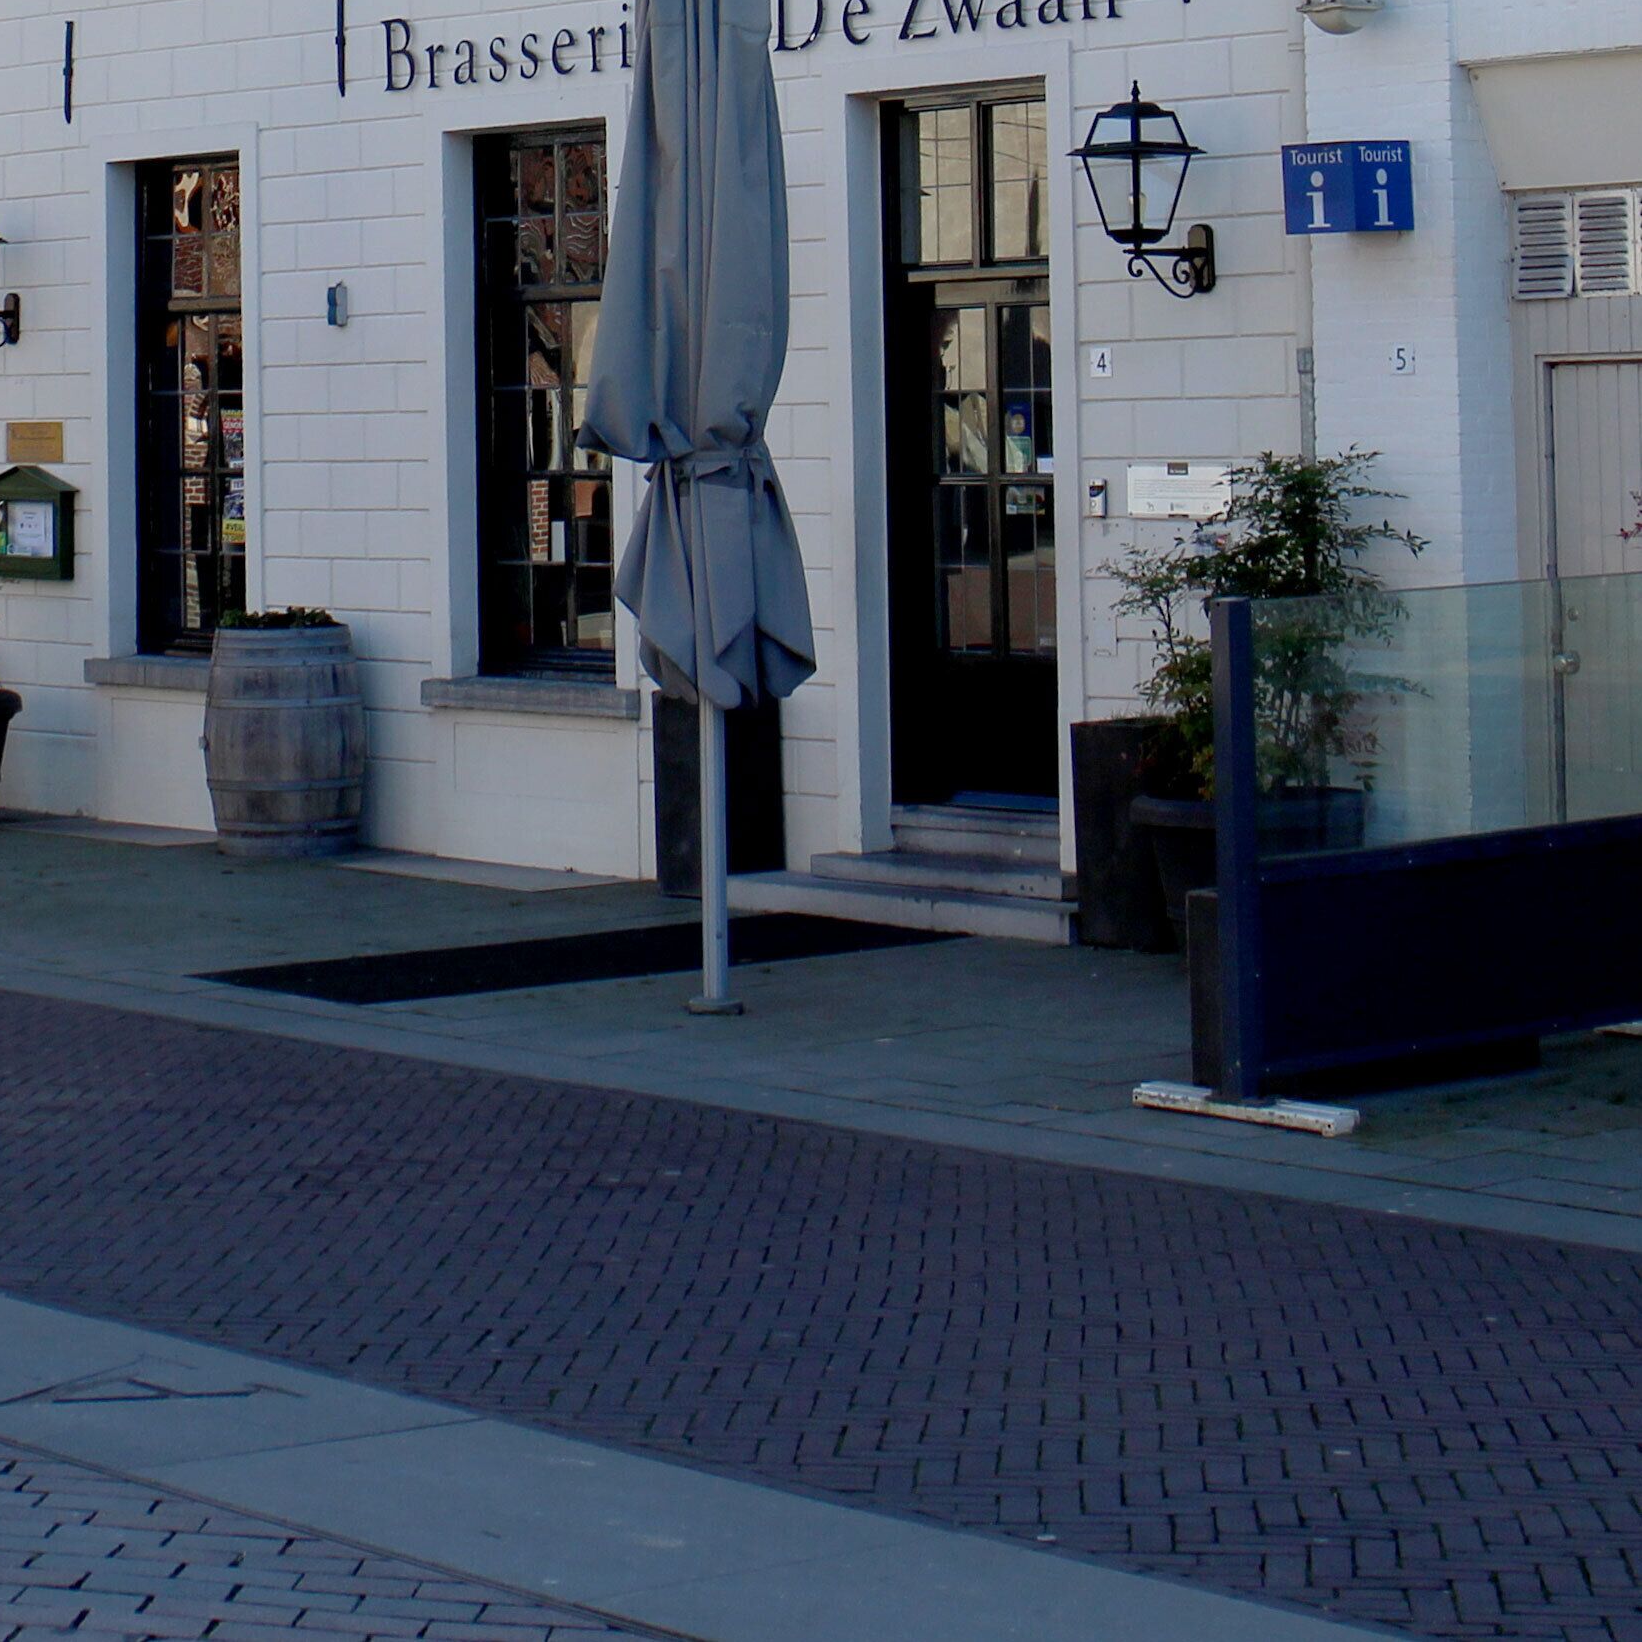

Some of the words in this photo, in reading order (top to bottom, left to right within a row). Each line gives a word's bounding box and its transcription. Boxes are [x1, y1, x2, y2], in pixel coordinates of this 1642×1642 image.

[381, 2, 632, 92] Brasseri
[1290, 147, 1343, 166] Tourist
[1358, 145, 1403, 163] Tourist
[1097, 352, 1107, 373] 4
[1396, 347, 1406, 371] 5
